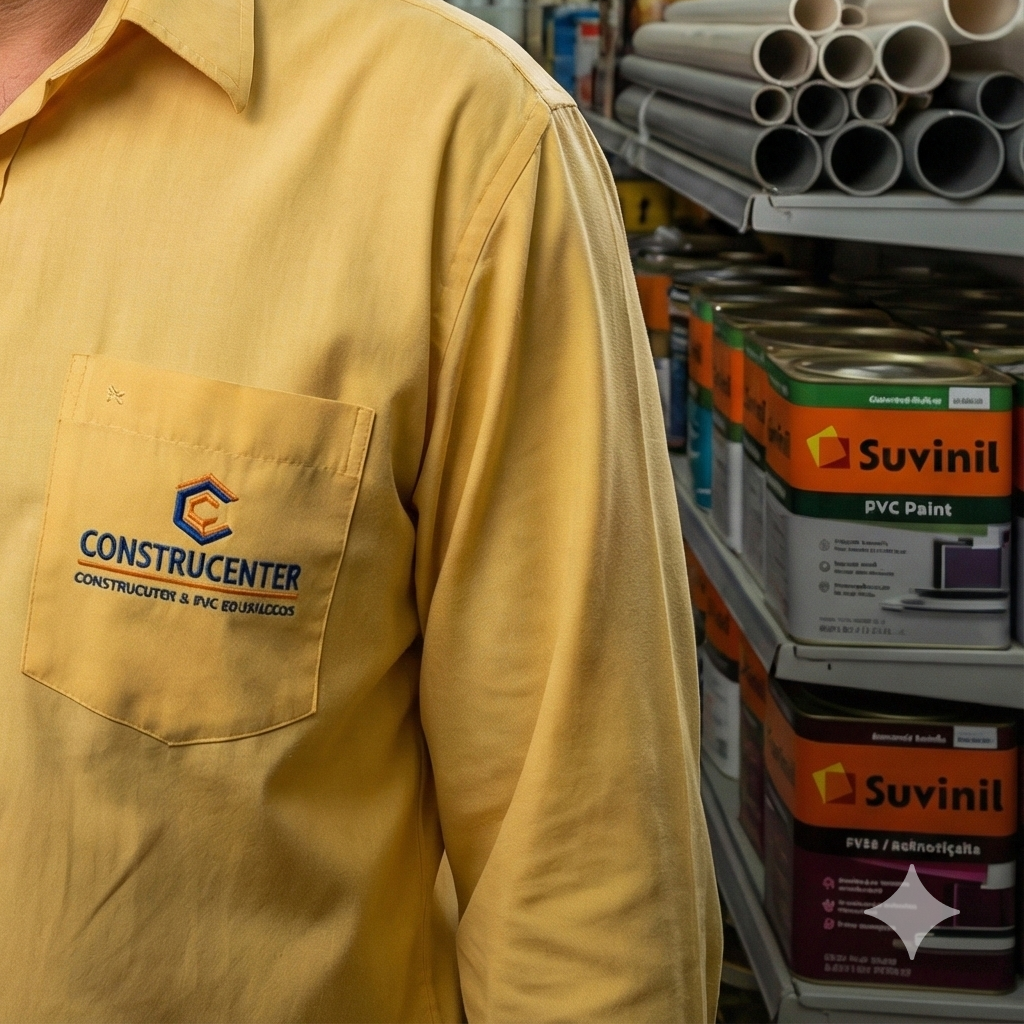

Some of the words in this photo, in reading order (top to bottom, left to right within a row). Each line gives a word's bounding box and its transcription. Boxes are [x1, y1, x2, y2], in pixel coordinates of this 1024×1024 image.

[859, 438, 1000, 474] Suvinil
[864, 500, 900, 516] PVC
[905, 501, 953, 517] Paint
[80, 529, 302, 591] CONSTRUCENTER
[865, 775, 1004, 812] Suvinil
